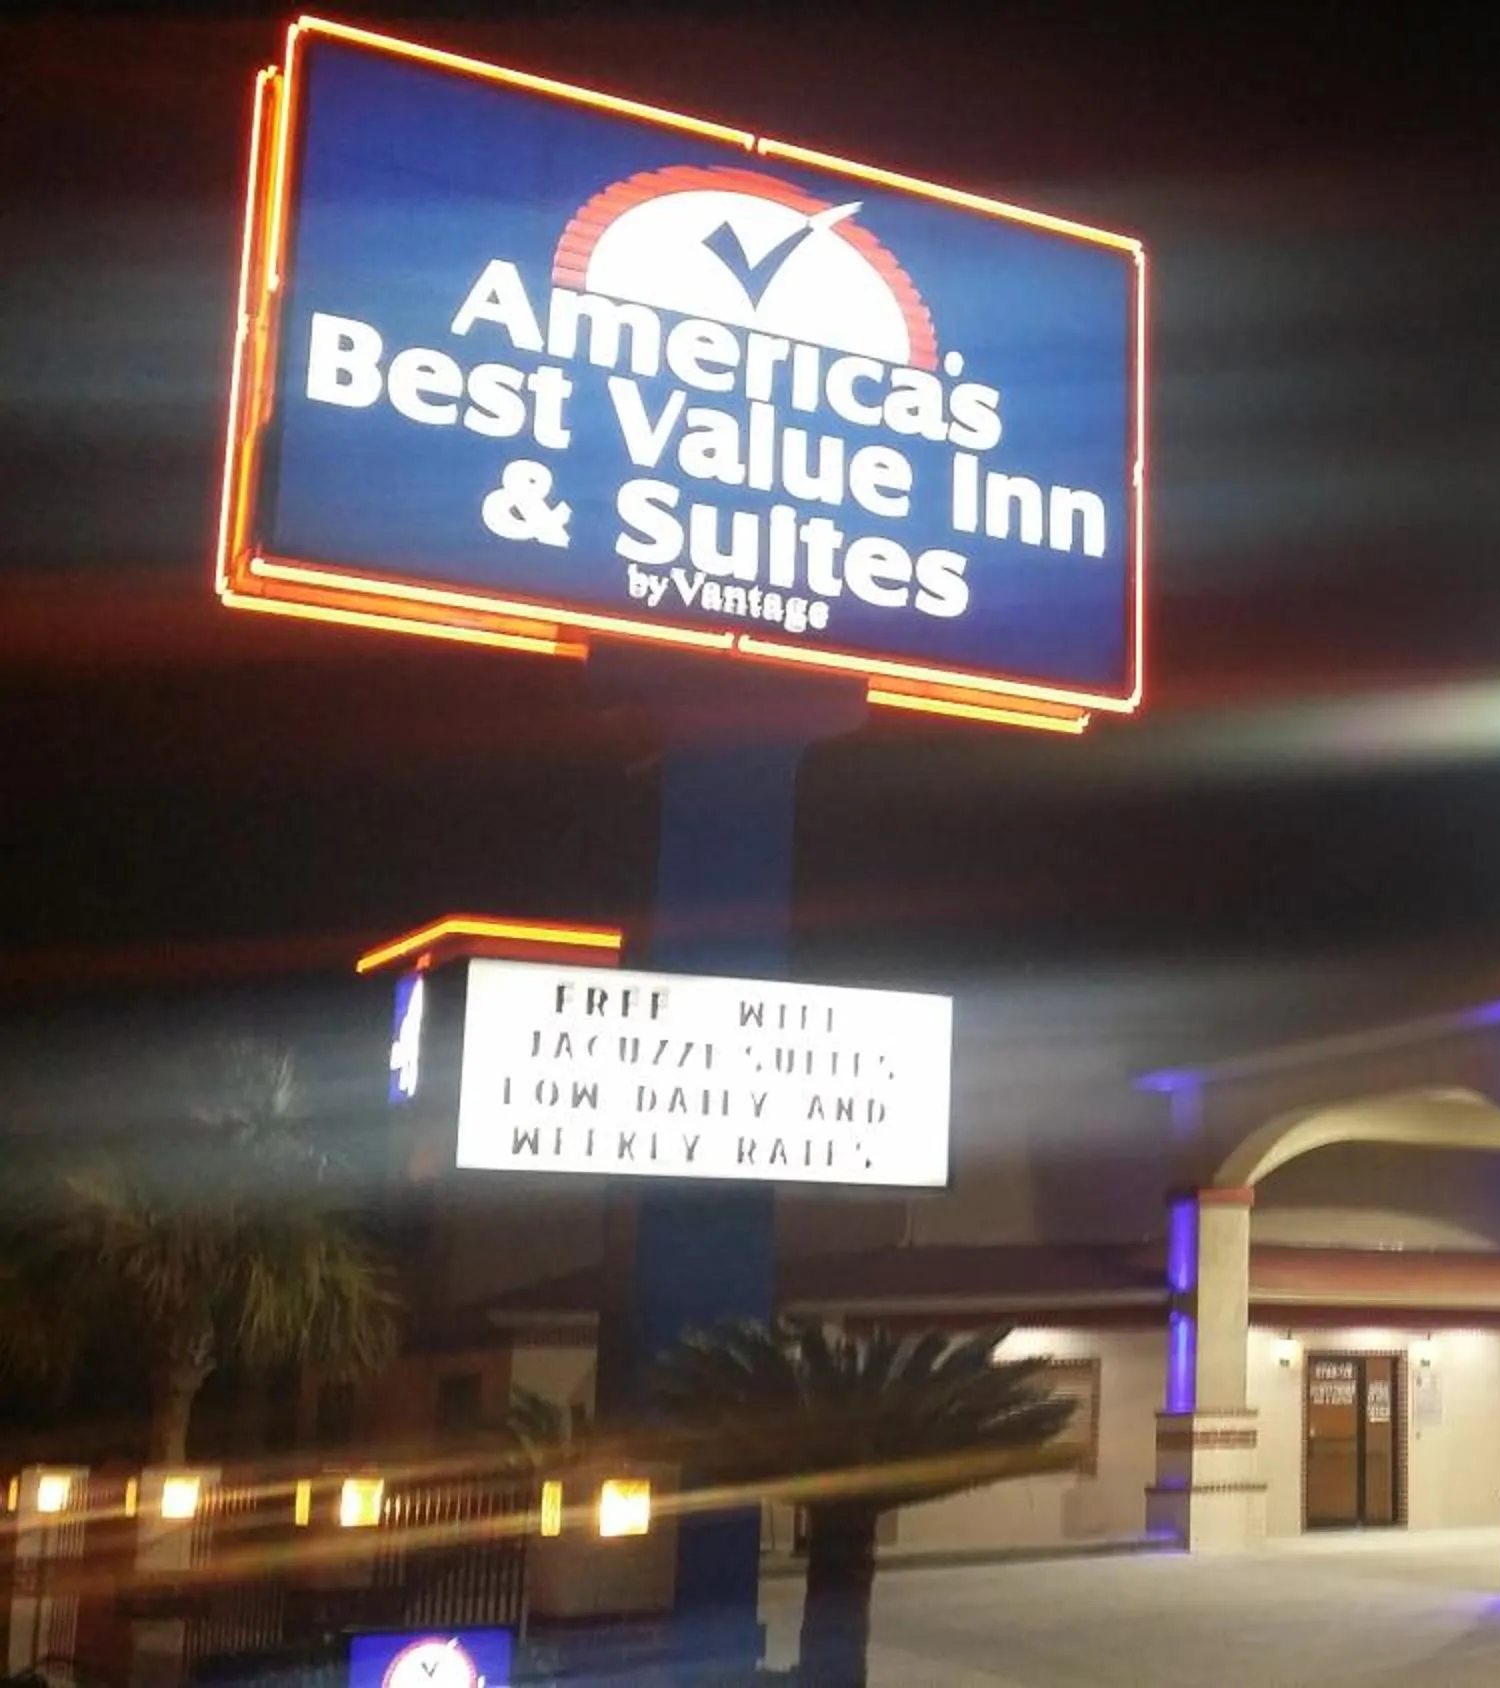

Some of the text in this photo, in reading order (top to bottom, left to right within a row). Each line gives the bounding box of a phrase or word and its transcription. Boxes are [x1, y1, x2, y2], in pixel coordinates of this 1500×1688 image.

[451, 259, 1003, 451] America's
[306, 312, 1107, 559] Best Value Inn
[481, 459, 971, 618] & Suites
[627, 562, 830, 632] by Vantage
[554, 981, 671, 1021] FREE
[501, 1075, 600, 1111] LOW
[806, 1094, 888, 1126] AND
